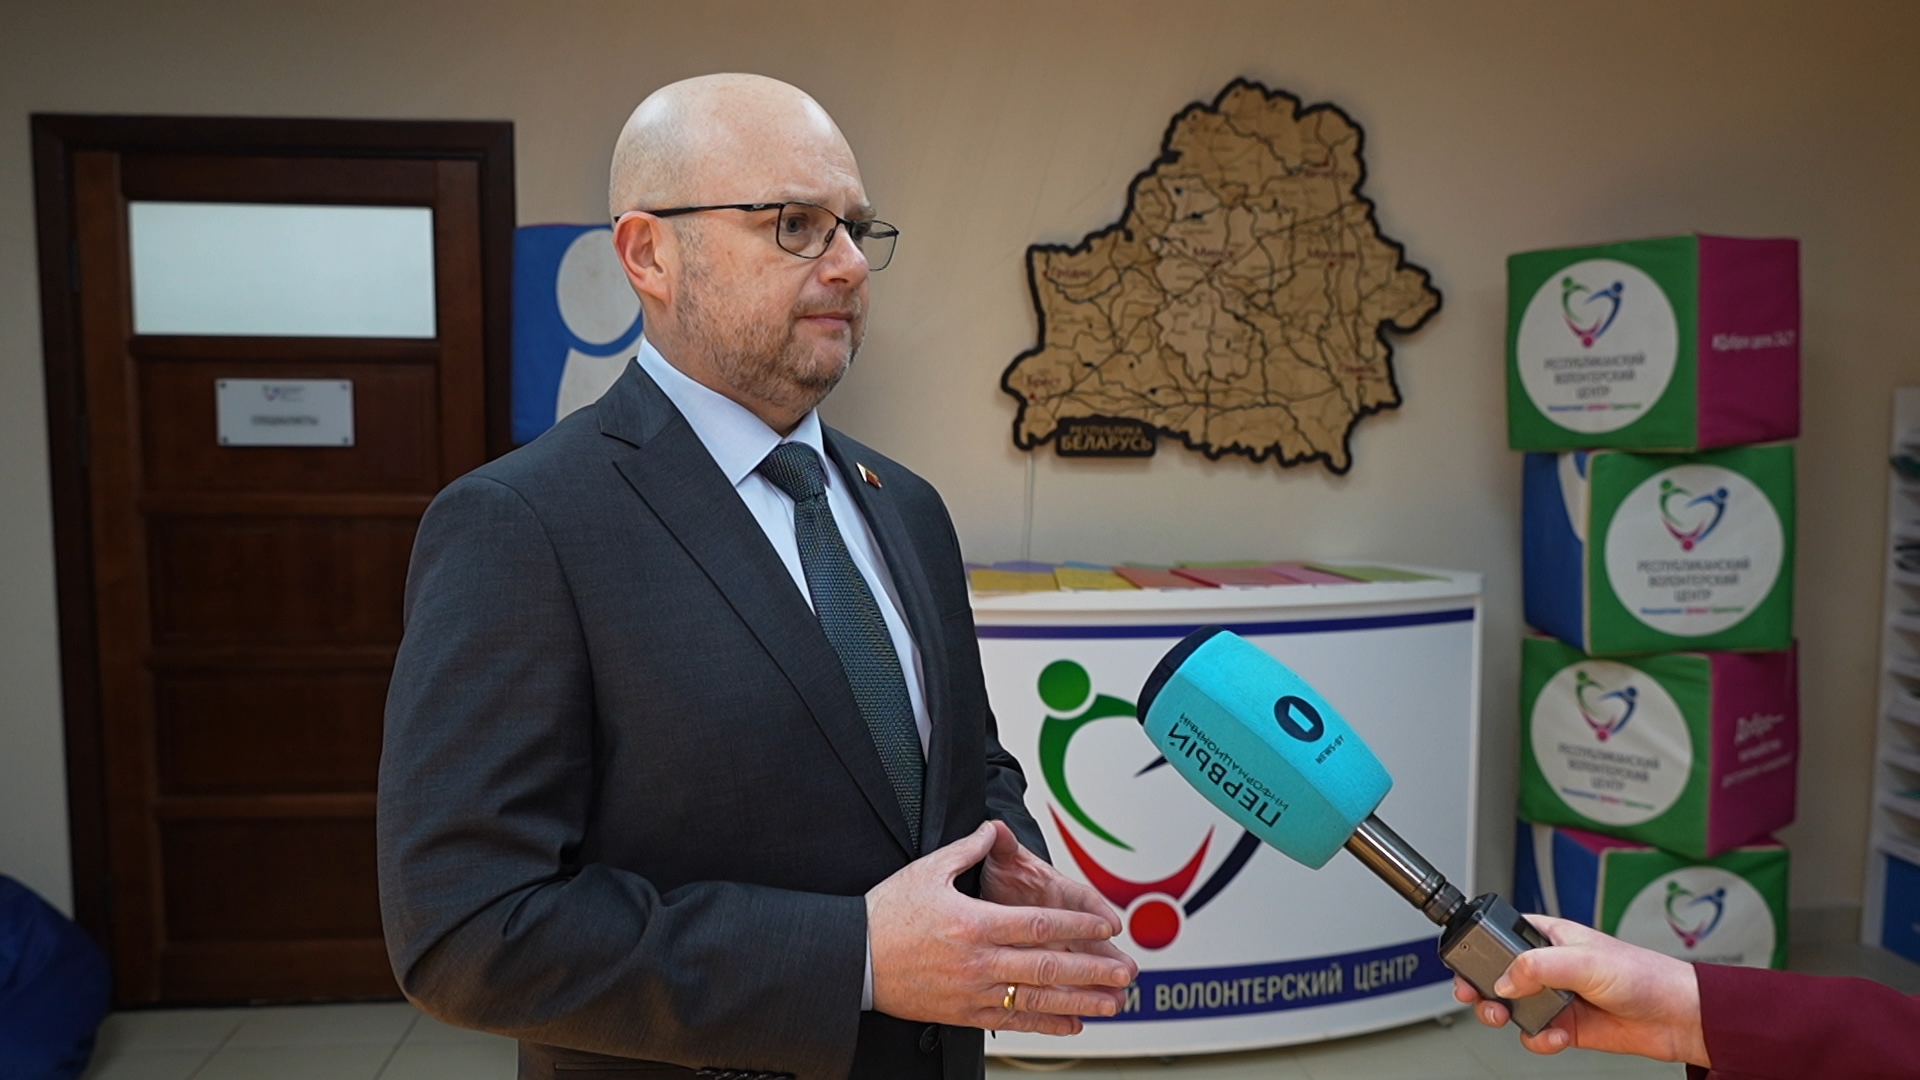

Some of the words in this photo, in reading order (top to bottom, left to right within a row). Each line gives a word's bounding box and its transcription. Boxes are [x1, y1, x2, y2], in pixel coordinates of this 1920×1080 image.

[1061, 435, 1153, 451] БЕЛАРУСЬ
[1637, 557, 1750, 572] РЕСПУБЛИКАНСКИЙ
[1673, 589, 1712, 602] ЦЕНТР
[1167, 721, 1282, 828] ПЕРВЫЙ
[1180, 712, 1289, 811] ИНФОРМАЦИОННЫЙ
[1155, 963, 1343, 1012] ВОЛОНТЕРСКИЙ
[1354, 953, 1420, 992] ЦЕНТР
